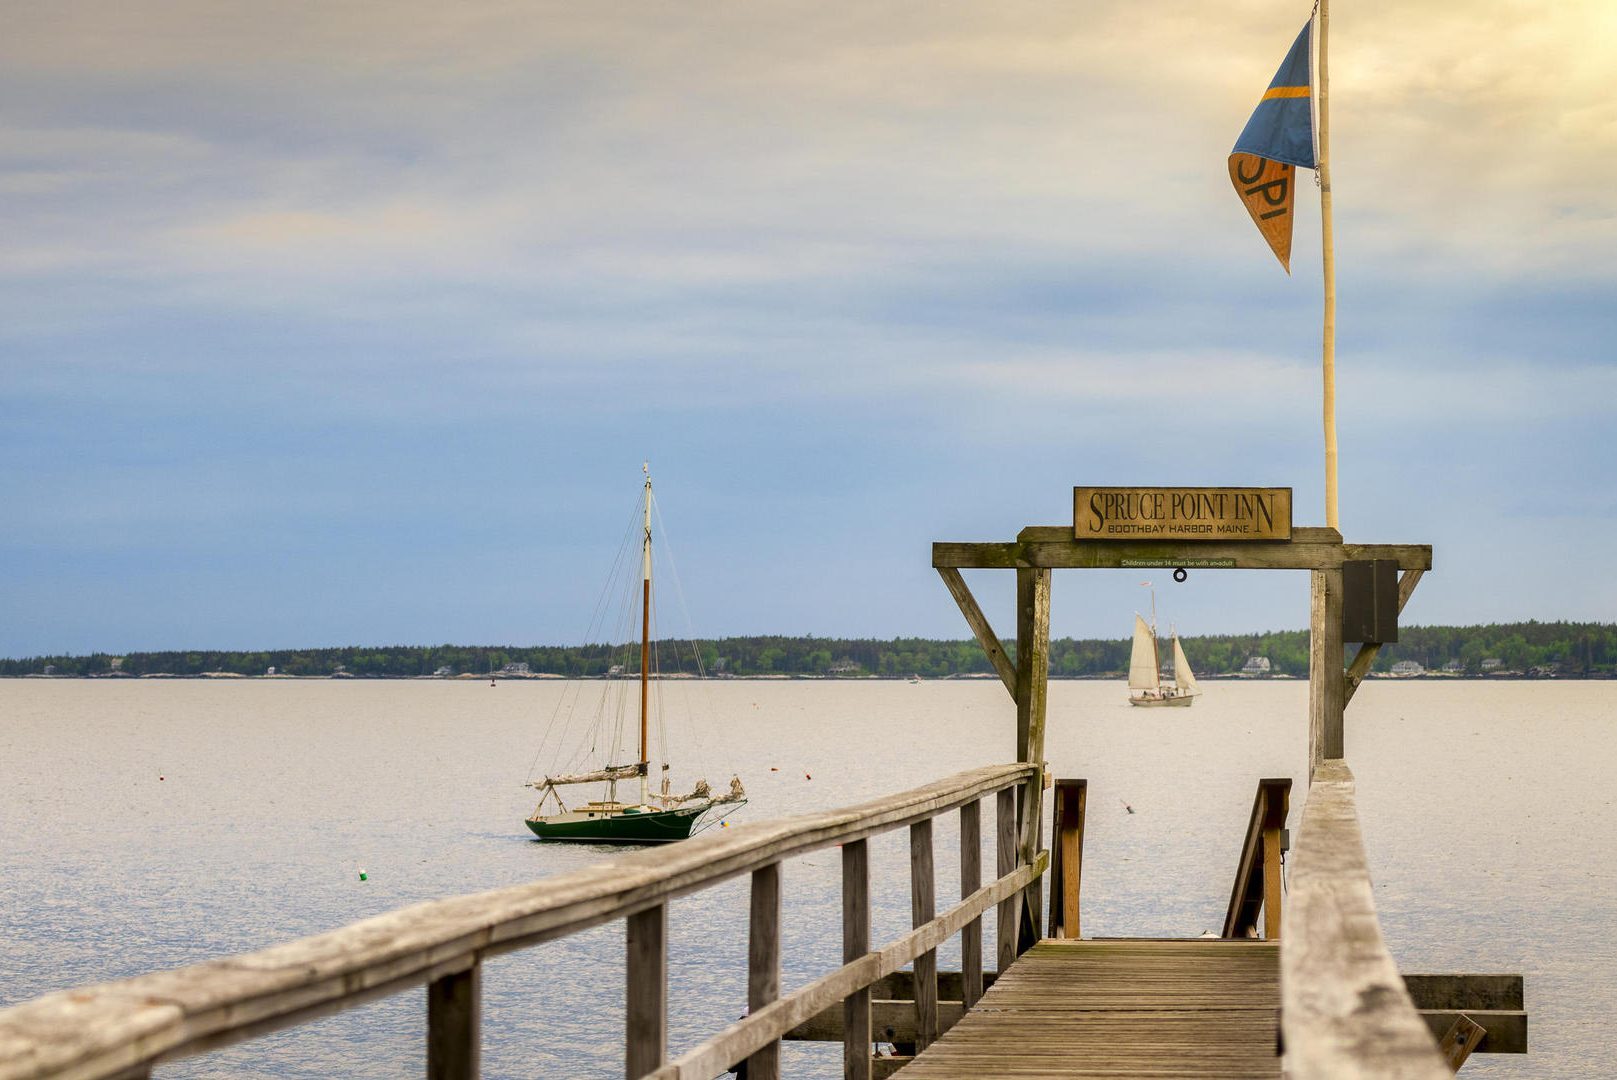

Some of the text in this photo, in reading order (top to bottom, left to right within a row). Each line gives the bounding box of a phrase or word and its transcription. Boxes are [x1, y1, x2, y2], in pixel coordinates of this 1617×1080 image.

[1089, 492, 1276, 533] SPRUCE POINT INN
[1108, 524, 1250, 534] BOOTHBAY HARBOR MAINE
[1121, 559, 1146, 567] Children
[1146, 559, 1163, 567] under
[1195, 559, 1209, 567] with
